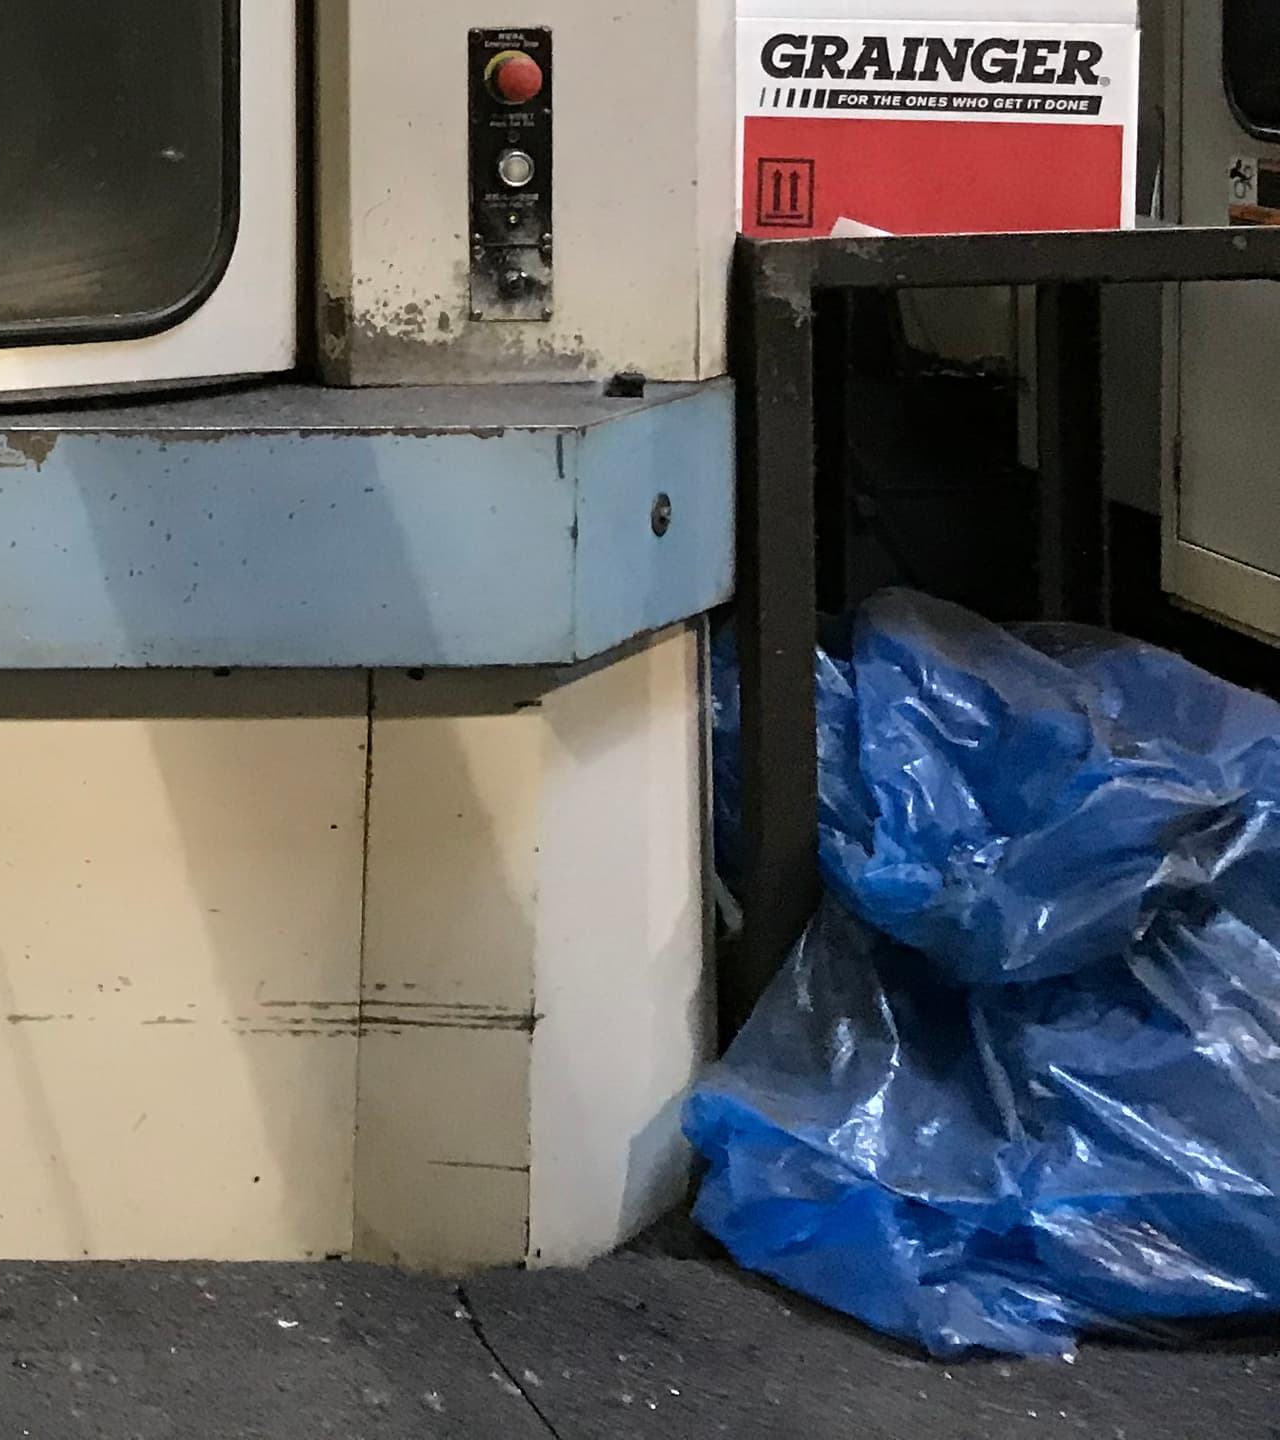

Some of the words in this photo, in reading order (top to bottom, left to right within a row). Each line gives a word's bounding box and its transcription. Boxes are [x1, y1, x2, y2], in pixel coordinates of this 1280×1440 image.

[760, 33, 1104, 86] GRAINGER
[837, 94, 869, 105] FOR
[873, 95, 902, 106] THE
[905, 95, 948, 107] ONES
[952, 97, 989, 108] WHO
[993, 98, 1023, 109] GET
[1027, 99, 1042, 110] IT
[1044, 99, 1090, 111] DONE
